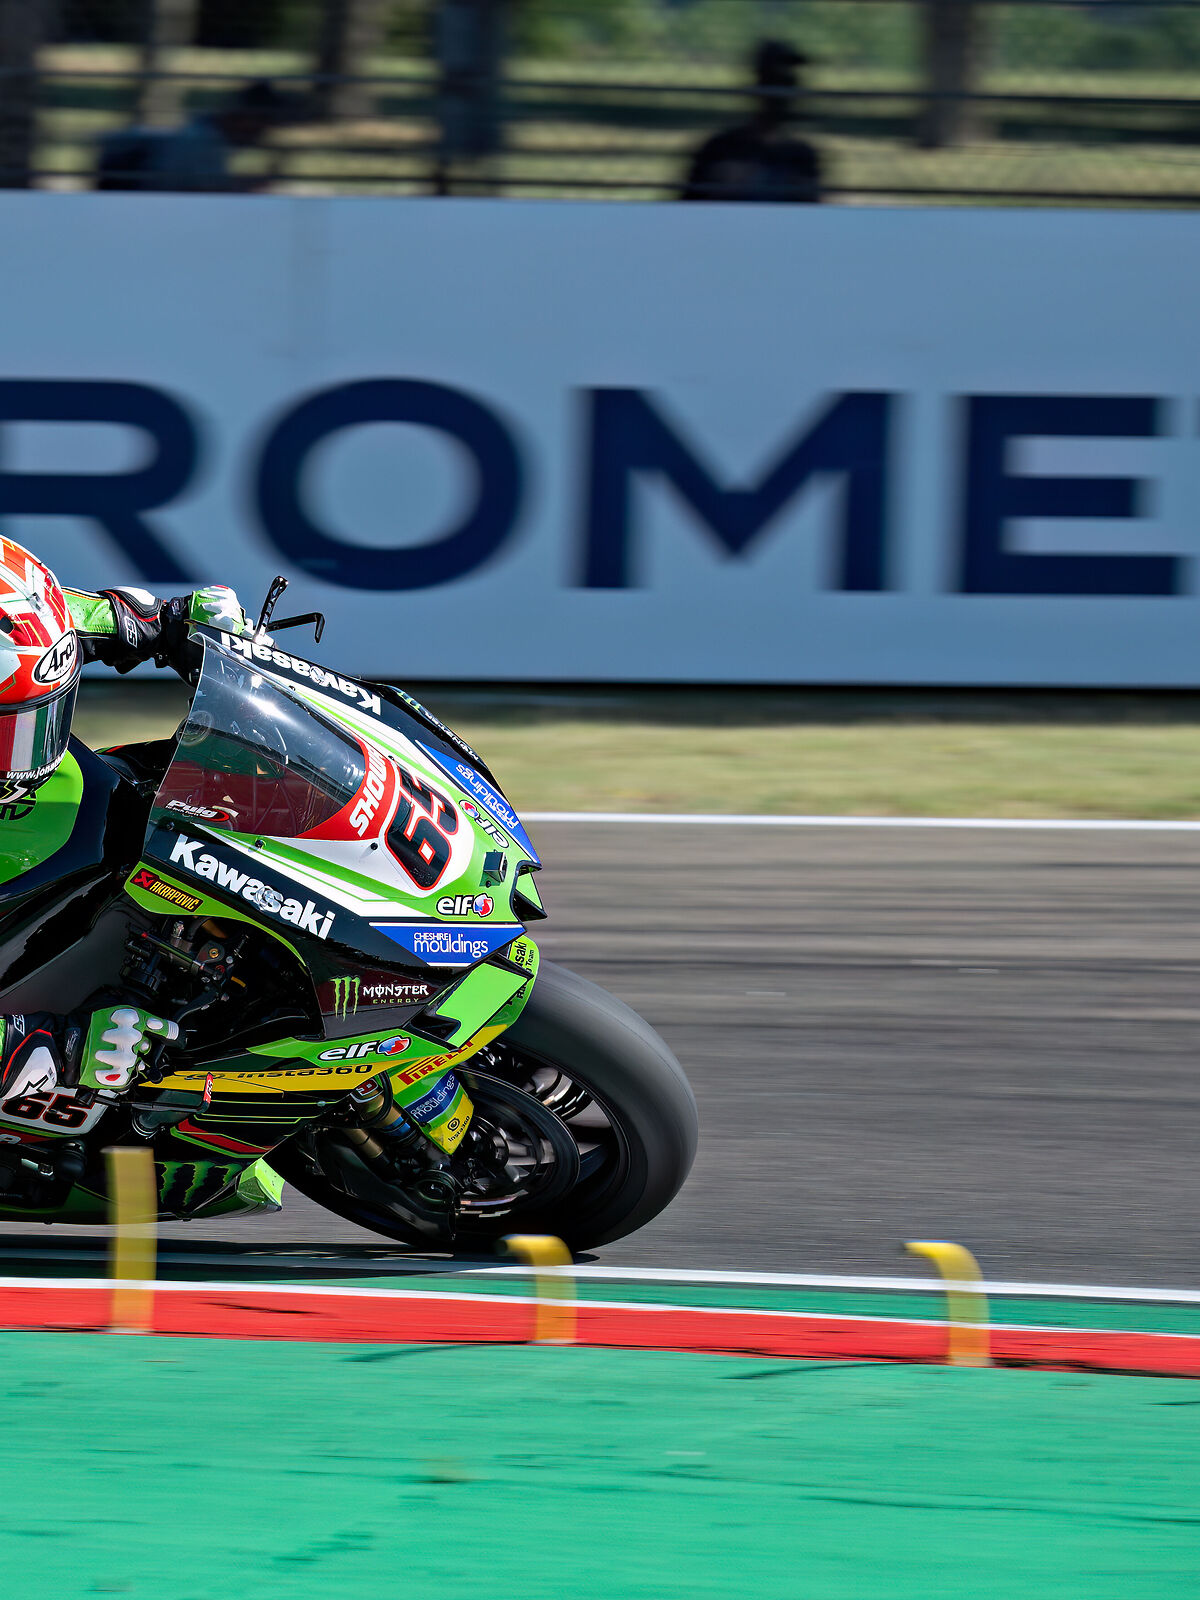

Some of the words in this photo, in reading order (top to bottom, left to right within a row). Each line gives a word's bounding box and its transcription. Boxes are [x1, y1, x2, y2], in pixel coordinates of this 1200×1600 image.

[221, 631, 381, 716] Kawasaki
[166, 799, 218, 818] Puig
[455, 763, 520, 828] mouldings
[384, 762, 459, 891] 65
[474, 816, 510, 849] elf
[169, 833, 336, 940] Kawasaki
[437, 895, 472, 916] elf
[413, 932, 449, 941] CHESHIRE
[413, 933, 489, 958] mouldings
[362, 983, 429, 998] MONSTER
[317, 1040, 378, 1062] elf
[1, 1091, 96, 1129] 65
[413, 1074, 455, 1119] mouldings
